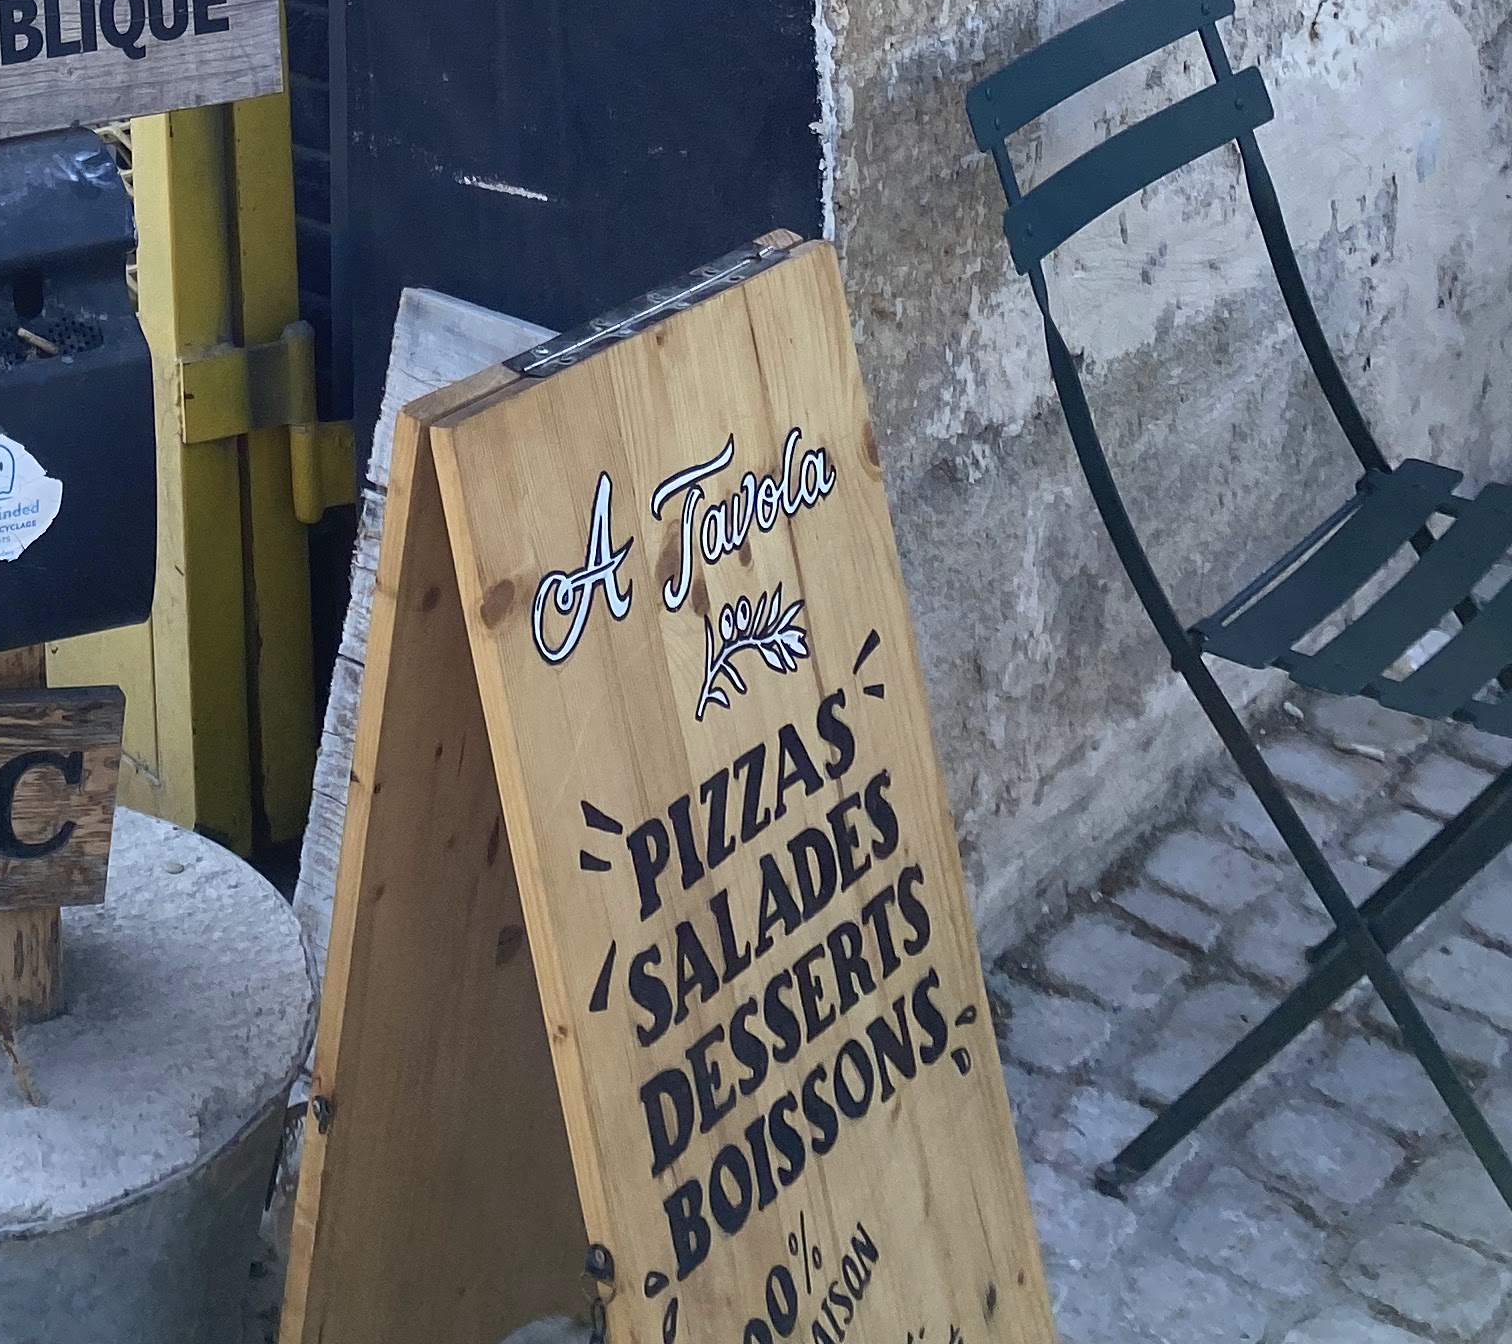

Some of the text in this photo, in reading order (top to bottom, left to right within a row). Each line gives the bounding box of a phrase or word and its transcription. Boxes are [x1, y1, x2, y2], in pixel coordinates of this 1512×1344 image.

[531, 426, 837, 665] A Tavola
[627, 687, 857, 924] PIZZAS
[628, 767, 902, 1048] SALADES
[639, 864, 931, 1179] DESSERTS
[663, 969, 950, 1283] BOISSONS
